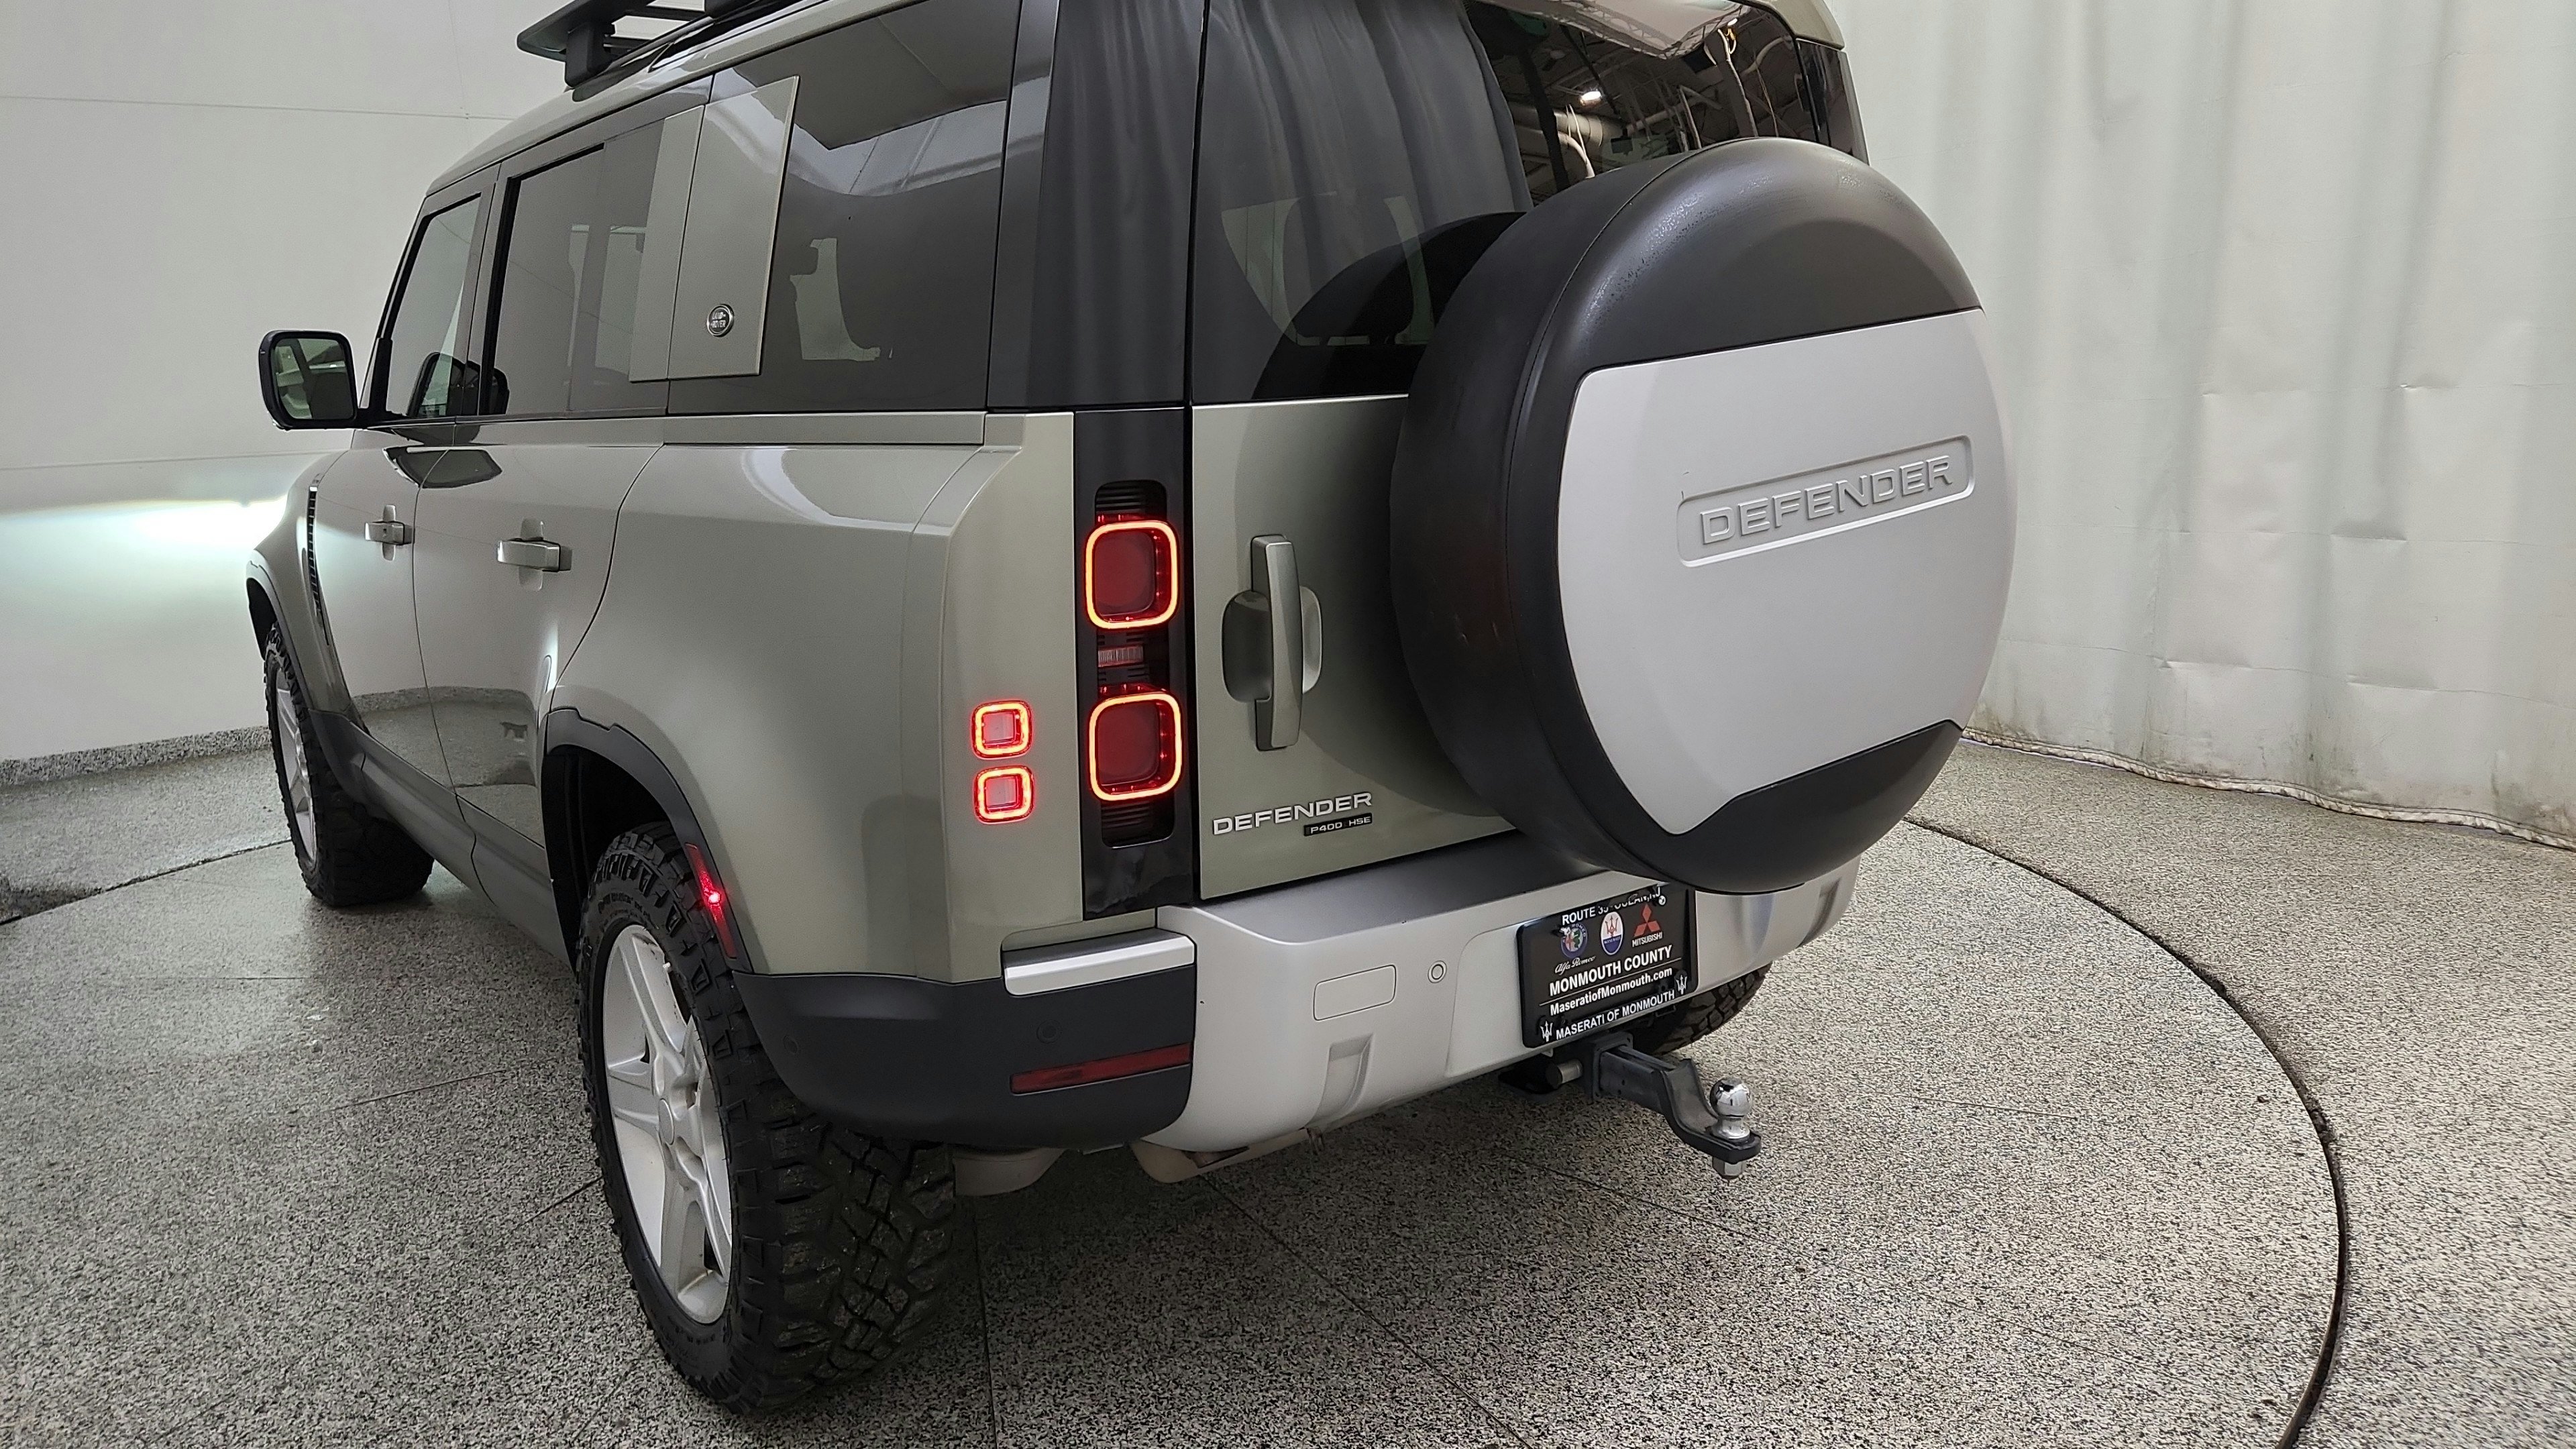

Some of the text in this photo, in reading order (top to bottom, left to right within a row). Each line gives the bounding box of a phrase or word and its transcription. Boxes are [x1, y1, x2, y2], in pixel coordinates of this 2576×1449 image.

[1700, 455, 1953, 545] DEFENDER
[1213, 792, 1373, 835] DEFENDER
[1310, 816, 1371, 834] P400 HSE
[1562, 906, 1596, 926] ROUTE
[1631, 932, 1663, 948] MITSUBISHI
[1550, 944, 1672, 996] MONMOUTH COUNTY
[1554, 955, 1596, 975] Alfa Romeo
[1550, 967, 1673, 1016] MaseratiofMonmouth.com
[1556, 989, 1674, 1040] MASERATI OF MONMOUTH
